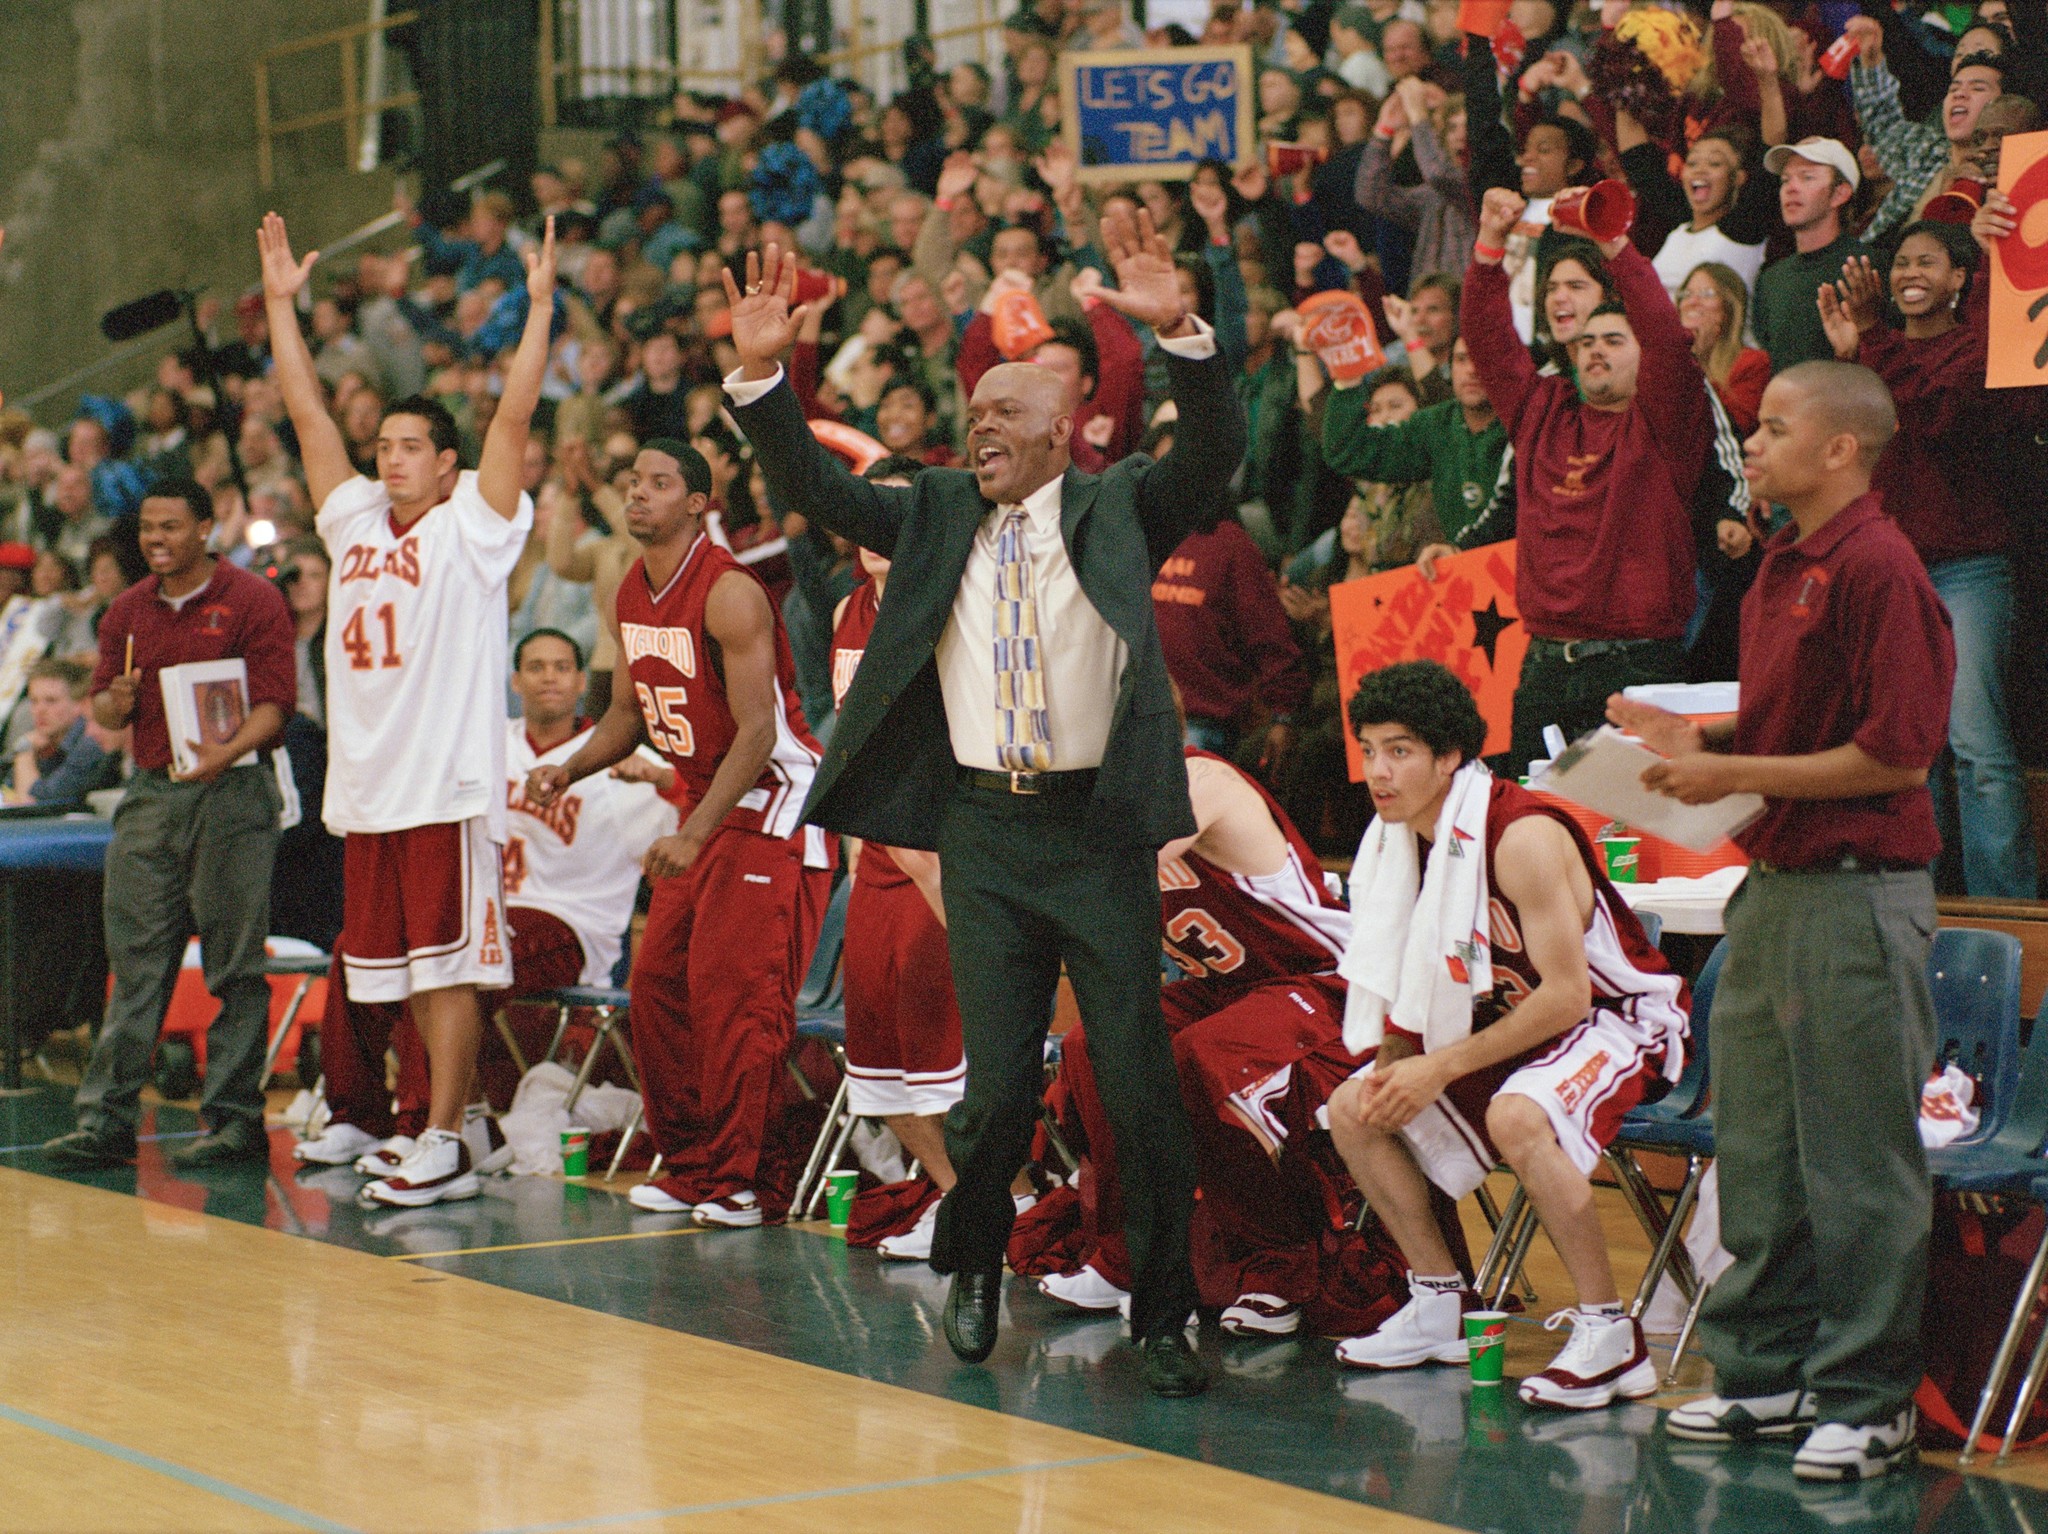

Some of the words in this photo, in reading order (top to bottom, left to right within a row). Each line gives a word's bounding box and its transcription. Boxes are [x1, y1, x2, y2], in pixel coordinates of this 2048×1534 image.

[1081, 67, 1176, 110] LETS
[1182, 64, 1237, 104] GO
[1112, 108, 1231, 160] TEAM
[341, 602, 403, 671] 41
[634, 681, 695, 757] 25
